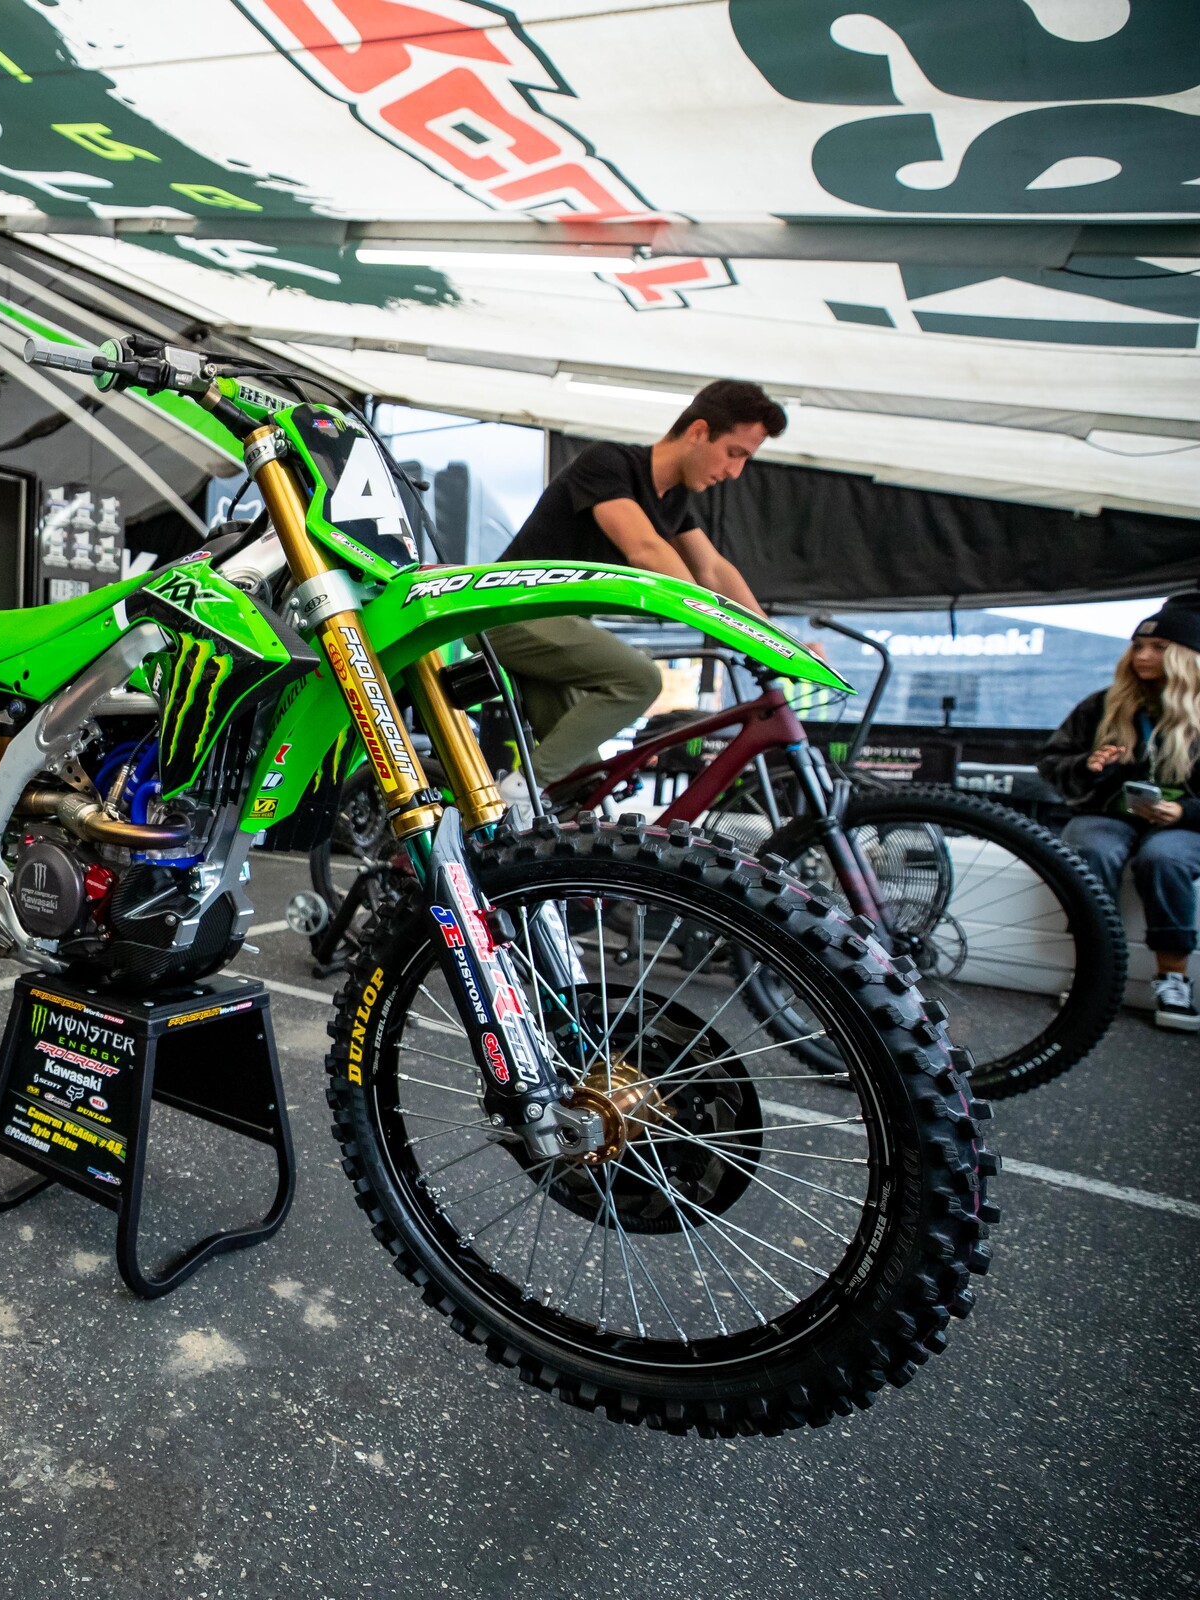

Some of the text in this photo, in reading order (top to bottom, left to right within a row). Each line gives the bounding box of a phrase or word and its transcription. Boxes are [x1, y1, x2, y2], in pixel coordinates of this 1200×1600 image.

[402, 573, 475, 607] PRO
[338, 628, 419, 778] PRO CIRCUIT
[345, 689, 393, 779] SHOWA
[21, 893, 58, 910] Kawasaki
[24, 902, 54, 915] Racing Team
[446, 864, 495, 963] BRAKING
[429, 905, 489, 1025] JE PISTONS
[48, 1011, 136, 1056] MONSTER
[348, 966, 385, 1086] DUNLOP
[373, 1019, 386, 1048] EXCEL
[34, 1041, 120, 1077] PRO CIRCUIT
[58, 1036, 121, 1064] ENERGY
[482, 1032, 513, 1083] GUTS
[39, 1076, 63, 1090] SCOTT
[44, 1059, 102, 1092] Kawasaki
[76, 1106, 112, 1124] DUNLOP
[91, 1097, 106, 1109] BELL
[4, 1125, 51, 1153] @PCraceteam
[27, 1106, 63, 1129] Cameron
[63, 1121, 98, 1145] McAdoo
[31, 1123, 51, 1140] Kyle
[52, 1132, 79, 1152] Defoe
[868, 1214, 886, 1254] EXCEL
[857, 1254, 874, 1279] A60
